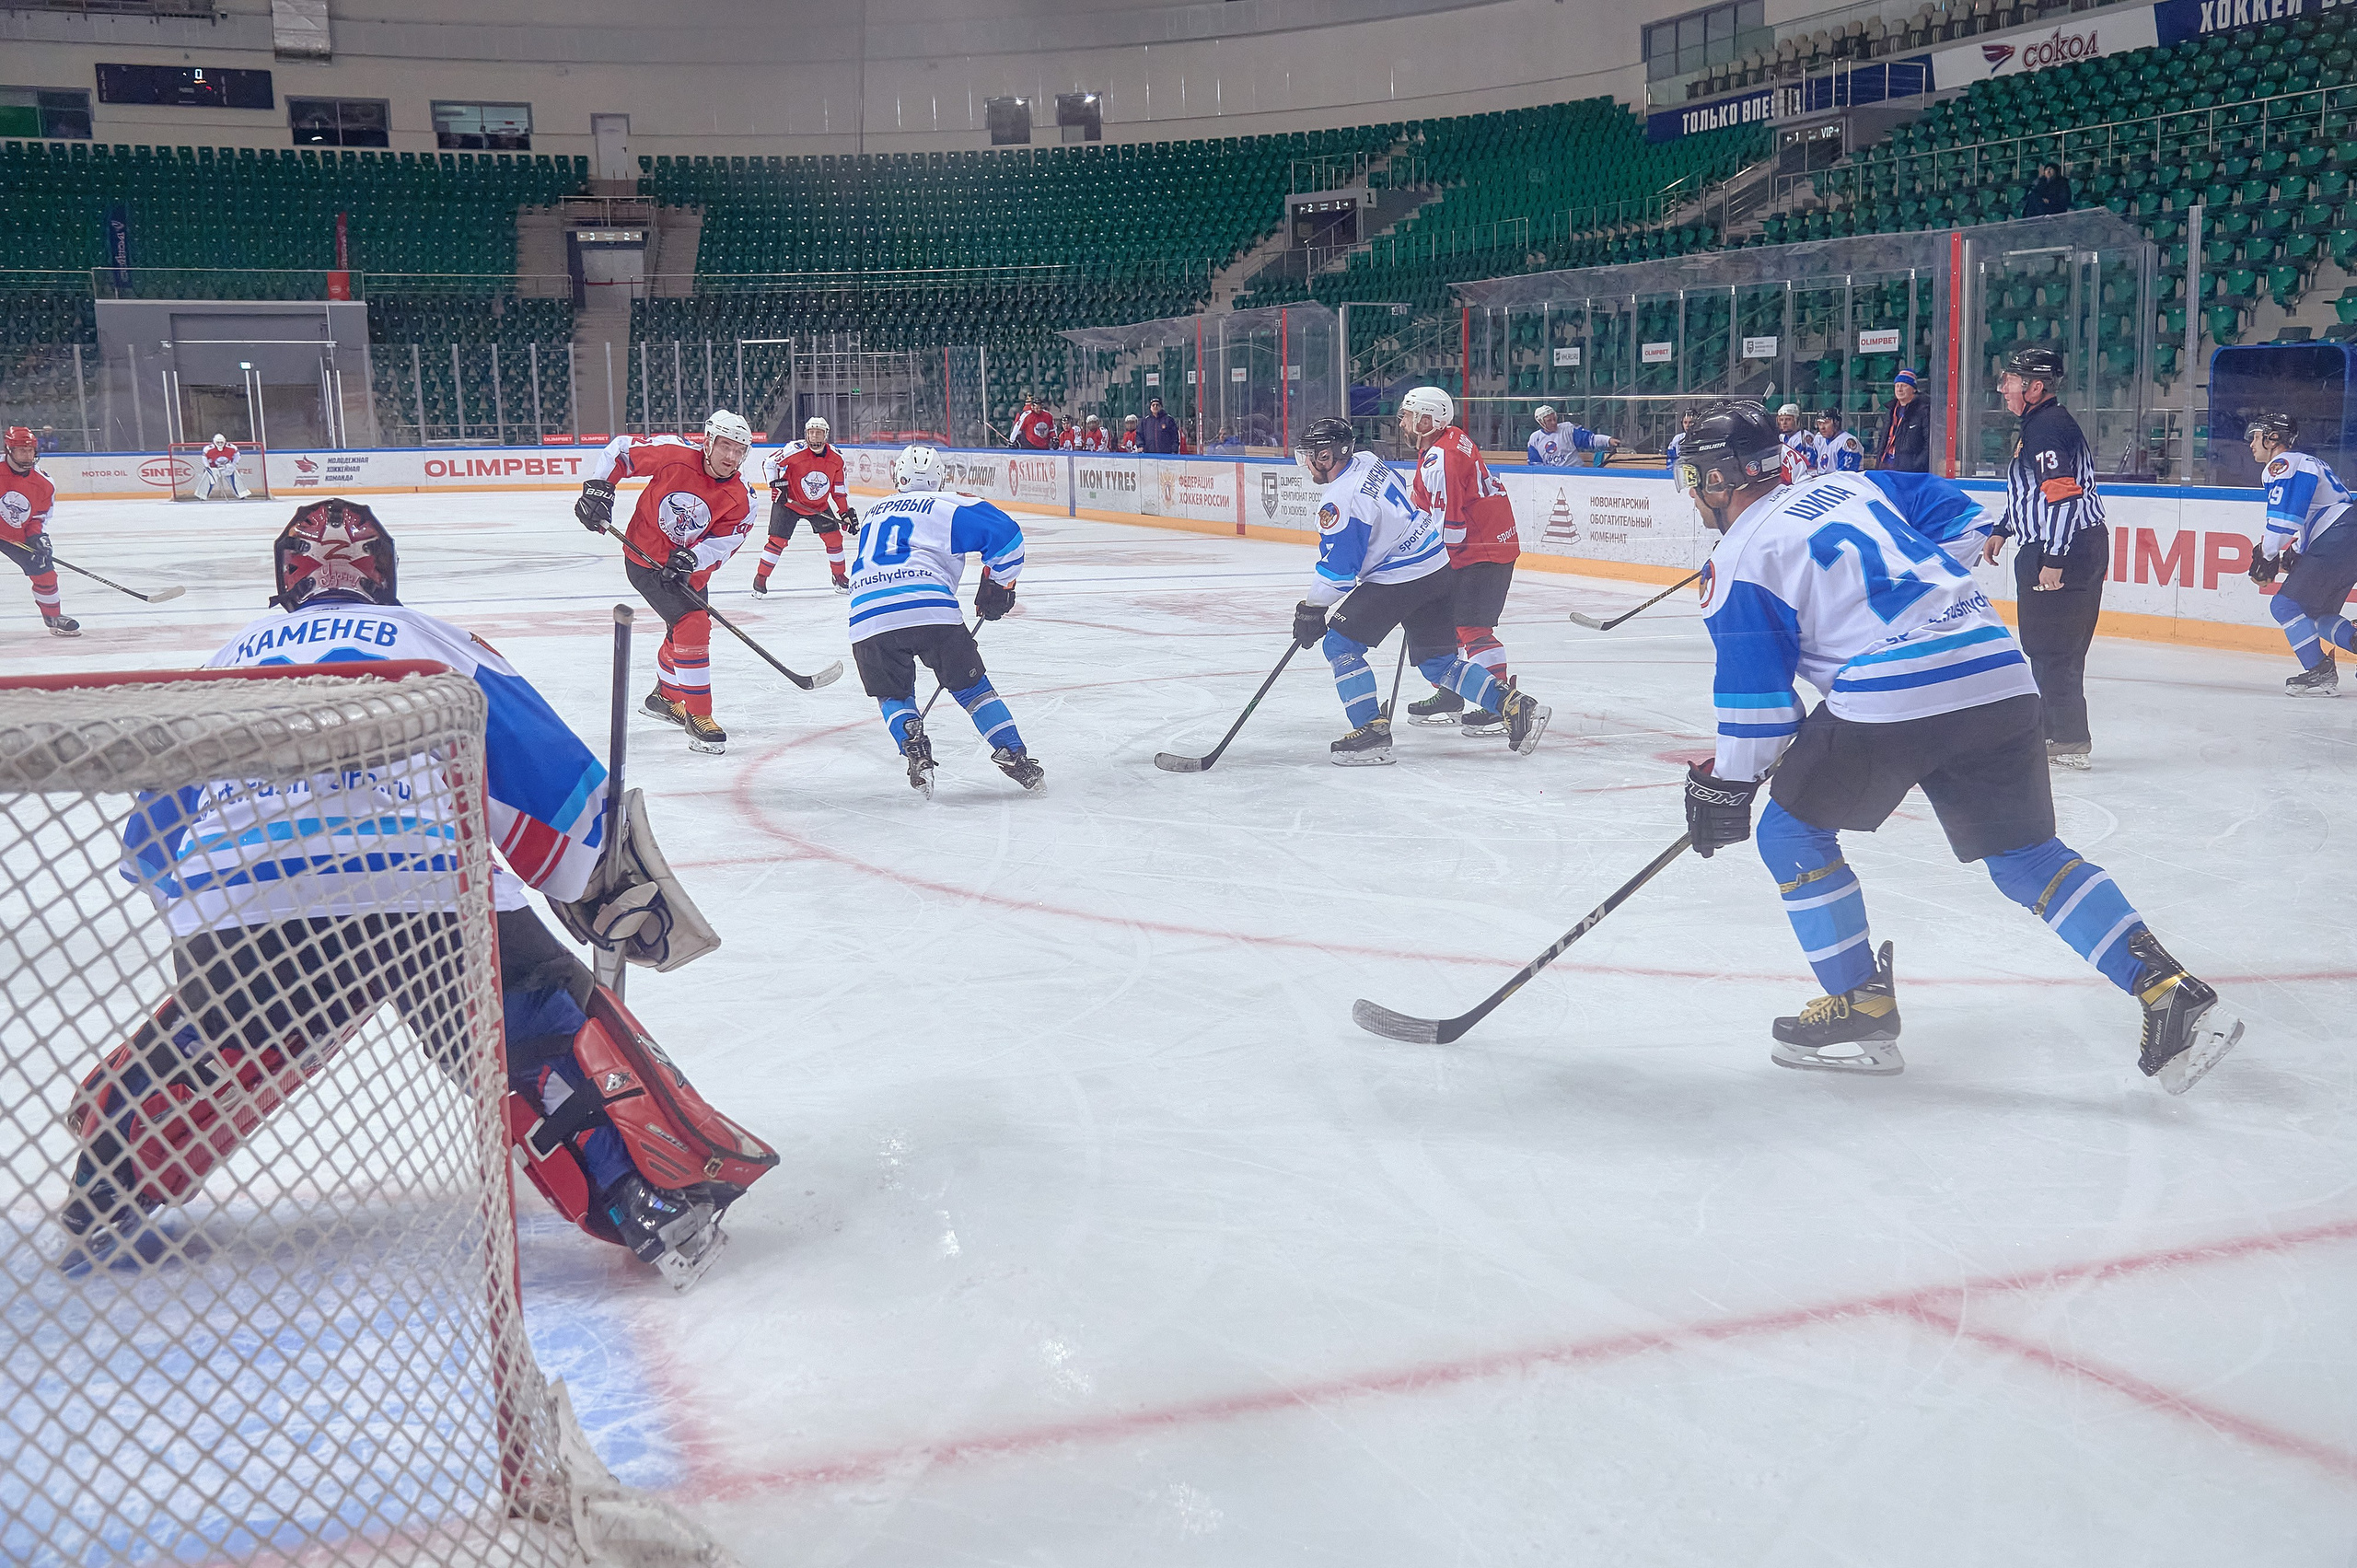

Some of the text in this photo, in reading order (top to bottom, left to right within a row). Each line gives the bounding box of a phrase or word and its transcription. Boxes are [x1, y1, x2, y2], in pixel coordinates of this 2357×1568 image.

[1682, 103, 1738, 135] ТОЛЬКО
[1820, 126, 1834, 138] VIP
[1366, 192, 1373, 203] 1
[1307, 203, 1314, 213] 2
[1335, 200, 1341, 210] 1
[589, 232, 596, 241] 3
[623, 232, 631, 241] 2
[1860, 336, 1898, 346] OLIMPBET
[1699, 442, 1726, 452] BAUER
[424, 458, 582, 478] OLIMPBET
[2035, 450, 2059, 473] 73
[141, 468, 192, 478] SINTEC
[1018, 460, 1049, 482] SALEK
[1079, 470, 1137, 493] IKON TYRES
[1178, 476, 1214, 491] ФЕДЕРАЦИЯ
[1360, 459, 1392, 502] ДЕМЧЕНК
[1178, 493, 1230, 507] ХОККЕЯ РОССИИ
[1383, 482, 1421, 522] 7
[1590, 496, 1650, 510] НОВОАНГАРСКИЙ
[1782, 484, 1857, 521] ШИПА
[1590, 513, 1653, 528] ОБОГАТИТЕЛЬНЫЙ
[1590, 530, 1627, 544] КОМБИНАТ
[1807, 499, 1971, 625] 24
[236, 618, 399, 664] КАМЕНЕВ
[1528, 903, 1606, 977] CCM
